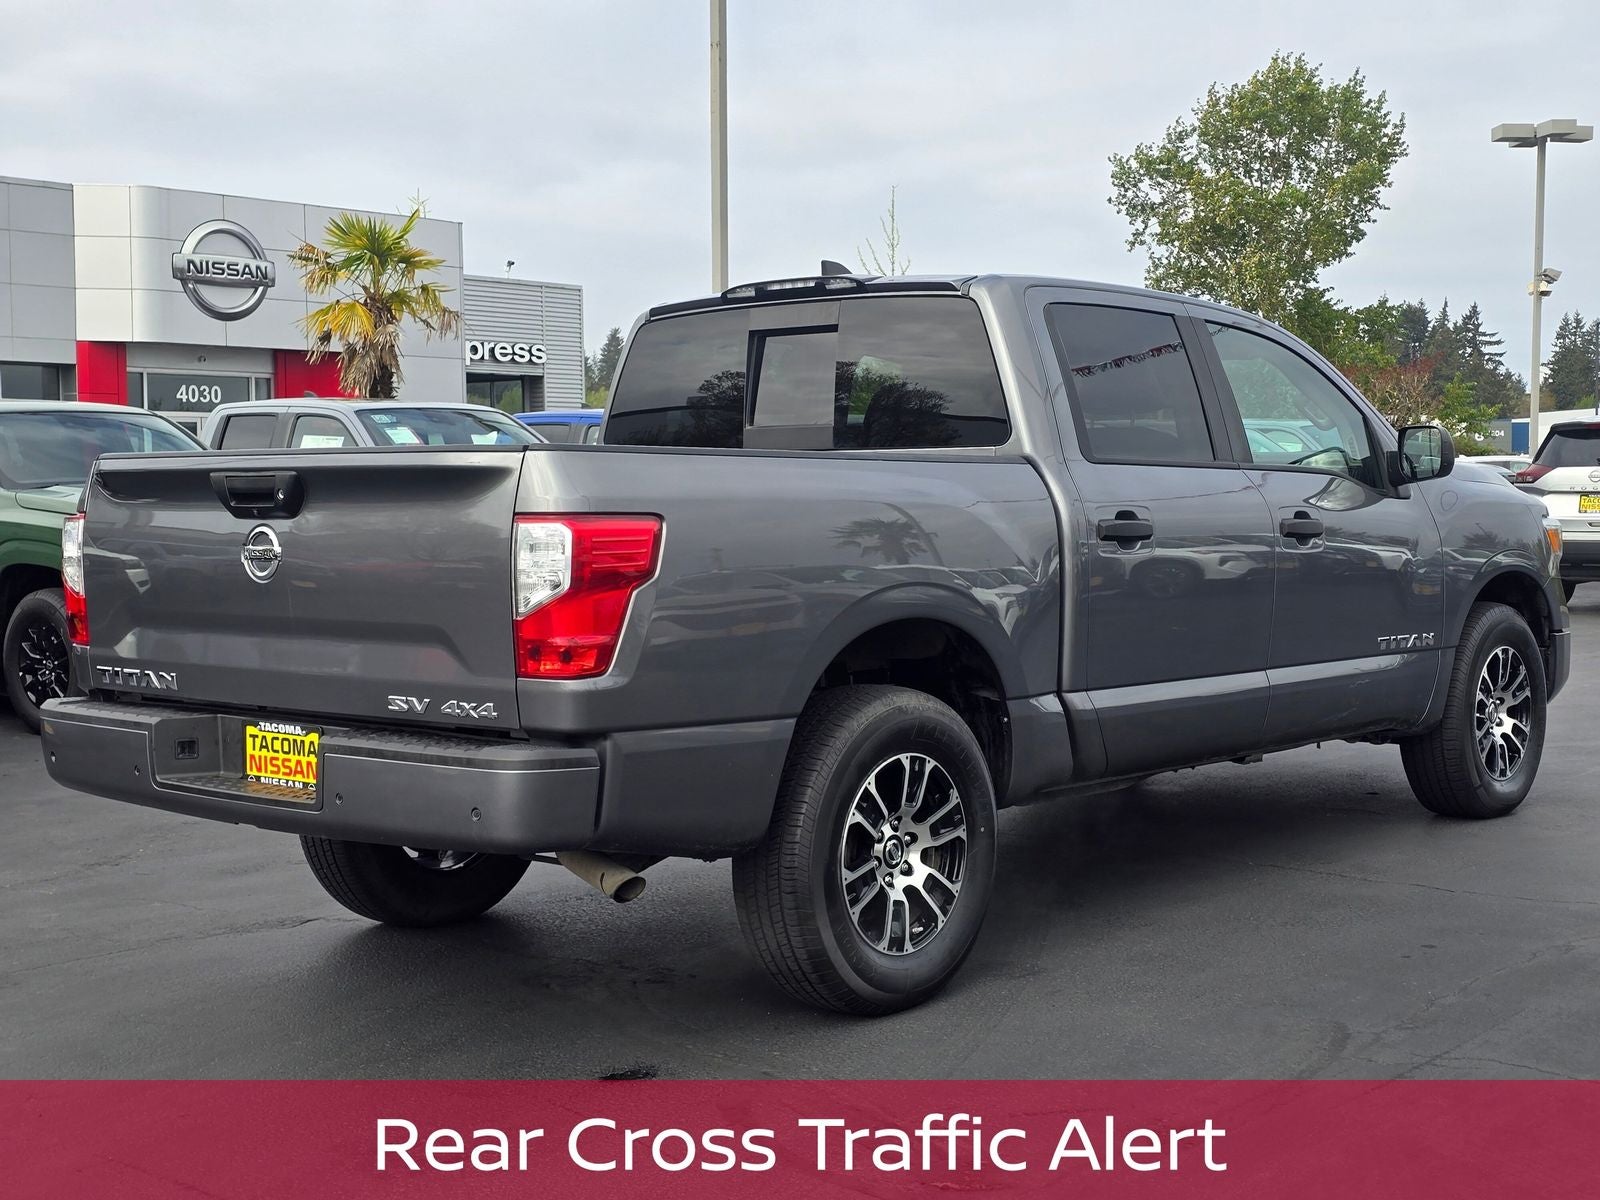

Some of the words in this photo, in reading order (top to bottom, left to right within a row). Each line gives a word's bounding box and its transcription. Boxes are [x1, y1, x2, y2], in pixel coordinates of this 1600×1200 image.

[186, 259, 269, 281] NISSAN
[465, 340, 548, 366] press
[176, 384, 222, 404] 4030
[1377, 632, 1435, 650] TITAN
[96, 665, 178, 691] TITAN
[387, 695, 431, 714] SV
[249, 733, 318, 759] TACOMA
[249, 754, 318, 781] NISSAN
